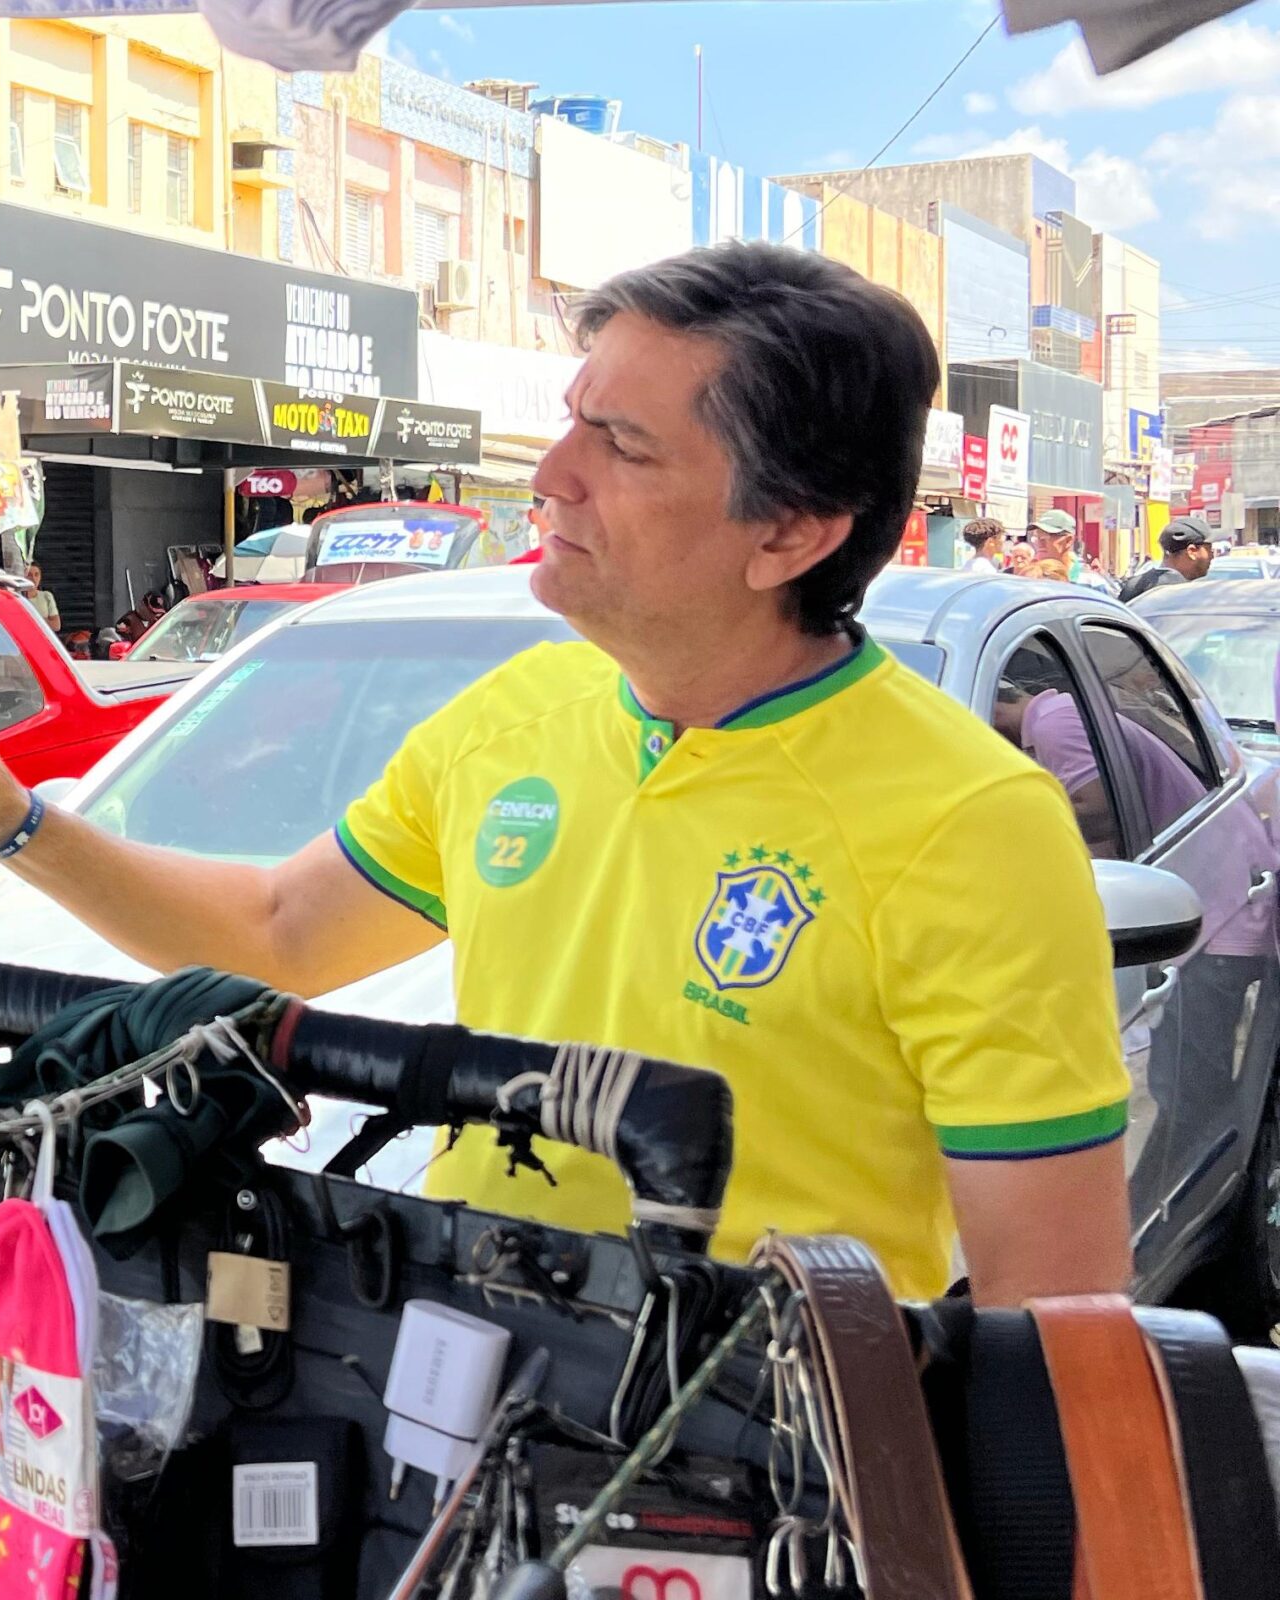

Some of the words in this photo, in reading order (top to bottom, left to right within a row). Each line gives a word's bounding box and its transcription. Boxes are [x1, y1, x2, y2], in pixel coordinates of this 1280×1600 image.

[20, 278, 136, 348] PONTO
[142, 301, 230, 363] FORTE
[285, 323, 360, 373] ATACADO
[361, 335, 373, 375] E
[45, 391, 96, 405] ATACADO
[97, 391, 105, 404] E
[45, 405, 62, 419] NO
[63, 404, 110, 419] VAREJO!
[150, 387, 196, 410] PONTO
[197, 394, 234, 414] FORTE
[298, 388, 344, 404] POSTO
[273, 403, 318, 435] MOTO
[335, 407, 370, 438] TAXI
[413, 420, 445, 437] PONTO
[446, 422, 473, 440] FORTE
[490, 835, 527, 868] 22
[731, 911, 769, 936] CBF
[683, 980, 751, 1025] BRASIL
[13, 1455, 67, 1506] LINDAS
[33, 1498, 66, 1529] MEIAS
